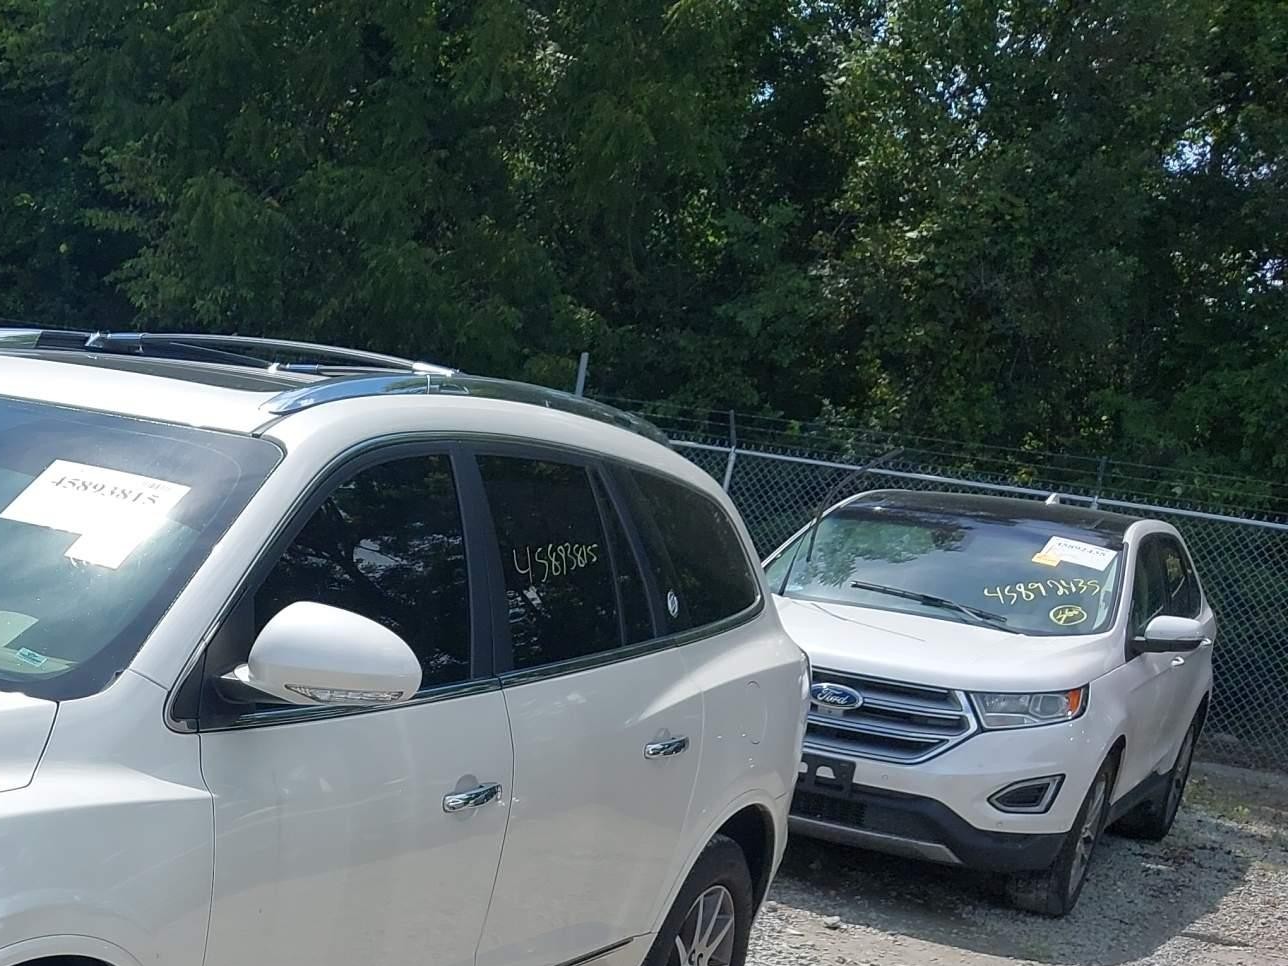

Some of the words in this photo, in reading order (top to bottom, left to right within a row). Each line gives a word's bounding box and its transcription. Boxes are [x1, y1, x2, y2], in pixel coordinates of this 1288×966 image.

[51, 475, 161, 505] 45893815
[512, 542, 599, 583] 45893815
[817, 688, 850, 704] Ford
